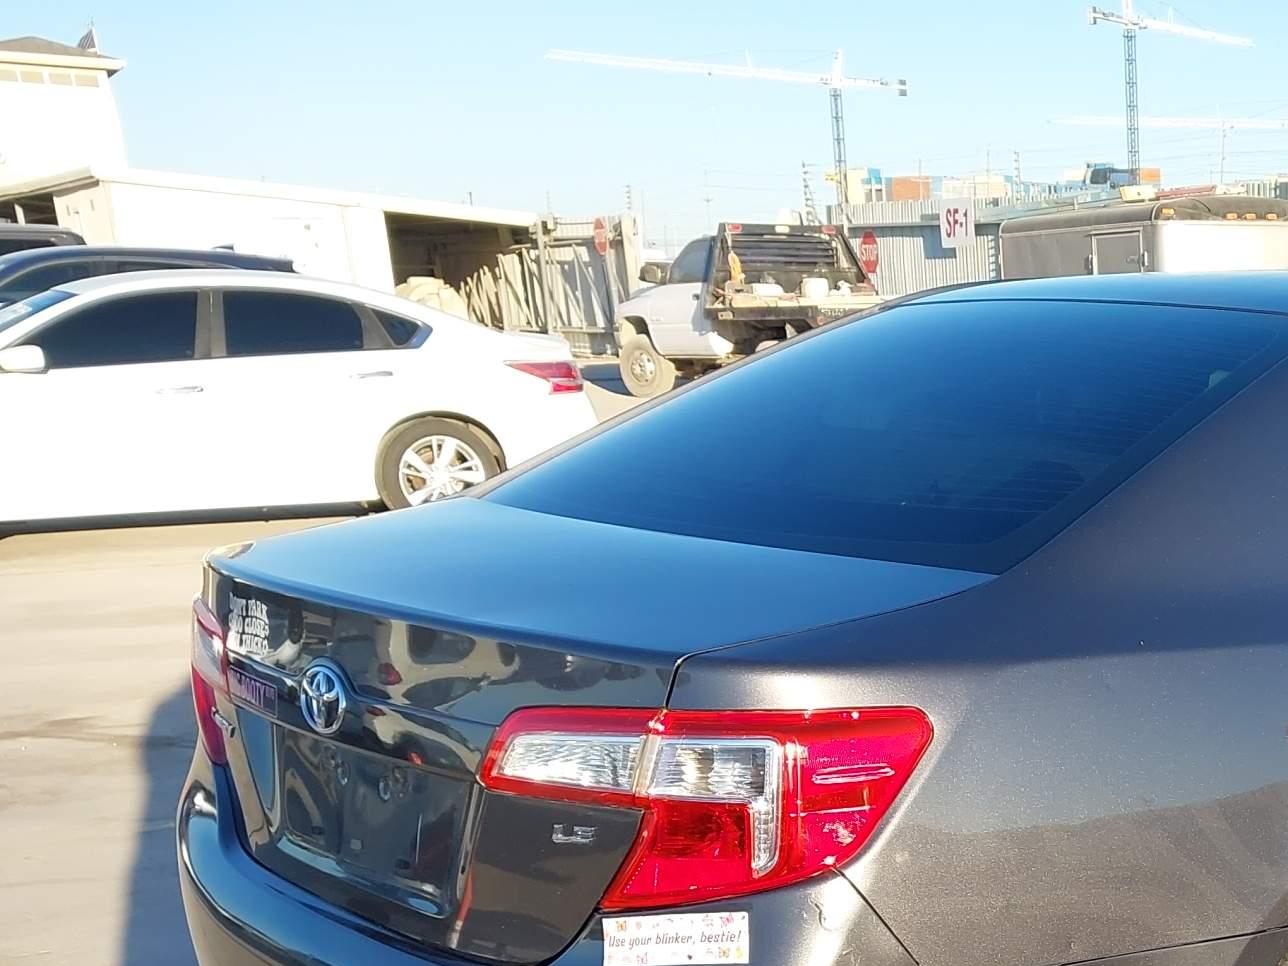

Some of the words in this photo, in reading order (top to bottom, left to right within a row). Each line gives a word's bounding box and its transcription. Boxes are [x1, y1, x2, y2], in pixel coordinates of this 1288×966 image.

[945, 207, 968, 238] SF-1
[861, 244, 878, 261] STOP
[552, 824, 597, 844] LE
[608, 935, 626, 948] Use
[628, 935, 652, 950] your
[655, 932, 696, 945] blinker,
[700, 930, 742, 943] bestie!
